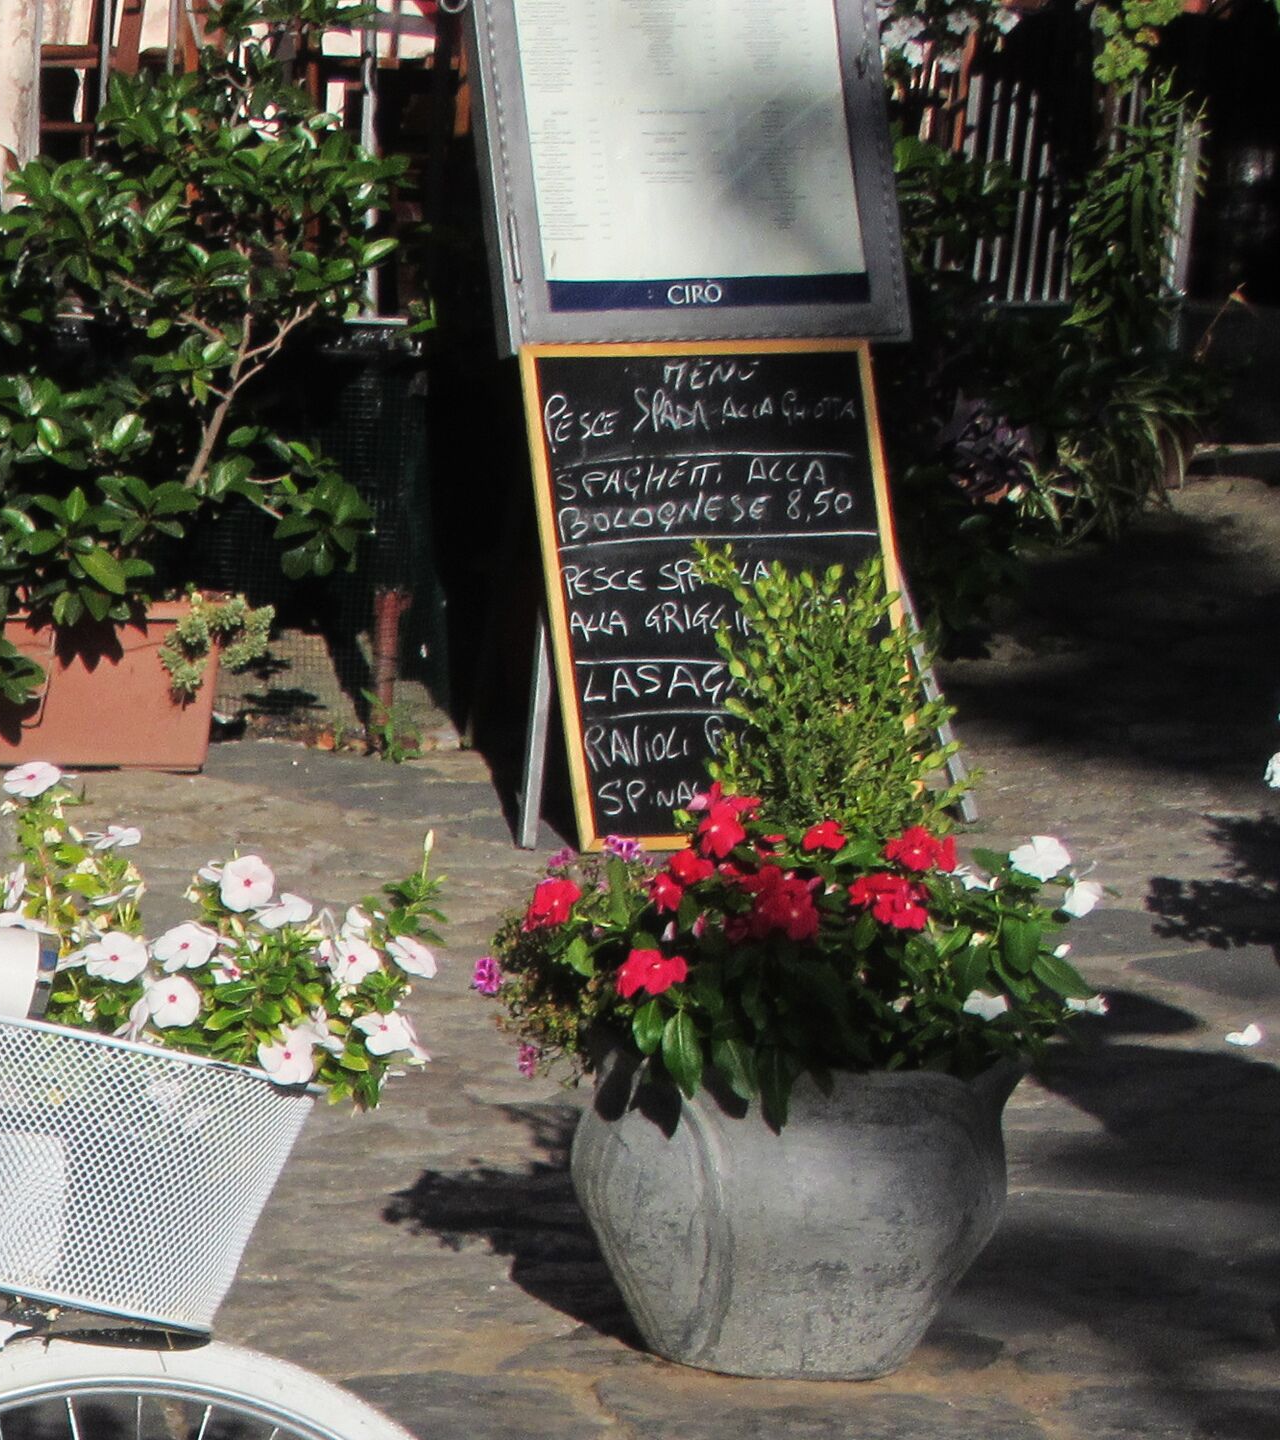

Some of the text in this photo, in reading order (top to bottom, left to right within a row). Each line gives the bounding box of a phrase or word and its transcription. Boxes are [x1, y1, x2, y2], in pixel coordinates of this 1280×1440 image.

[543, 394, 619, 453] PESCE
[781, 390, 856, 426] GHOTTA
[558, 487, 853, 542] BOLOGNESE 8,50
[561, 564, 646, 599] PESCE
[570, 609, 629, 642] ALLA
[584, 724, 689, 772] RAVIOLI
